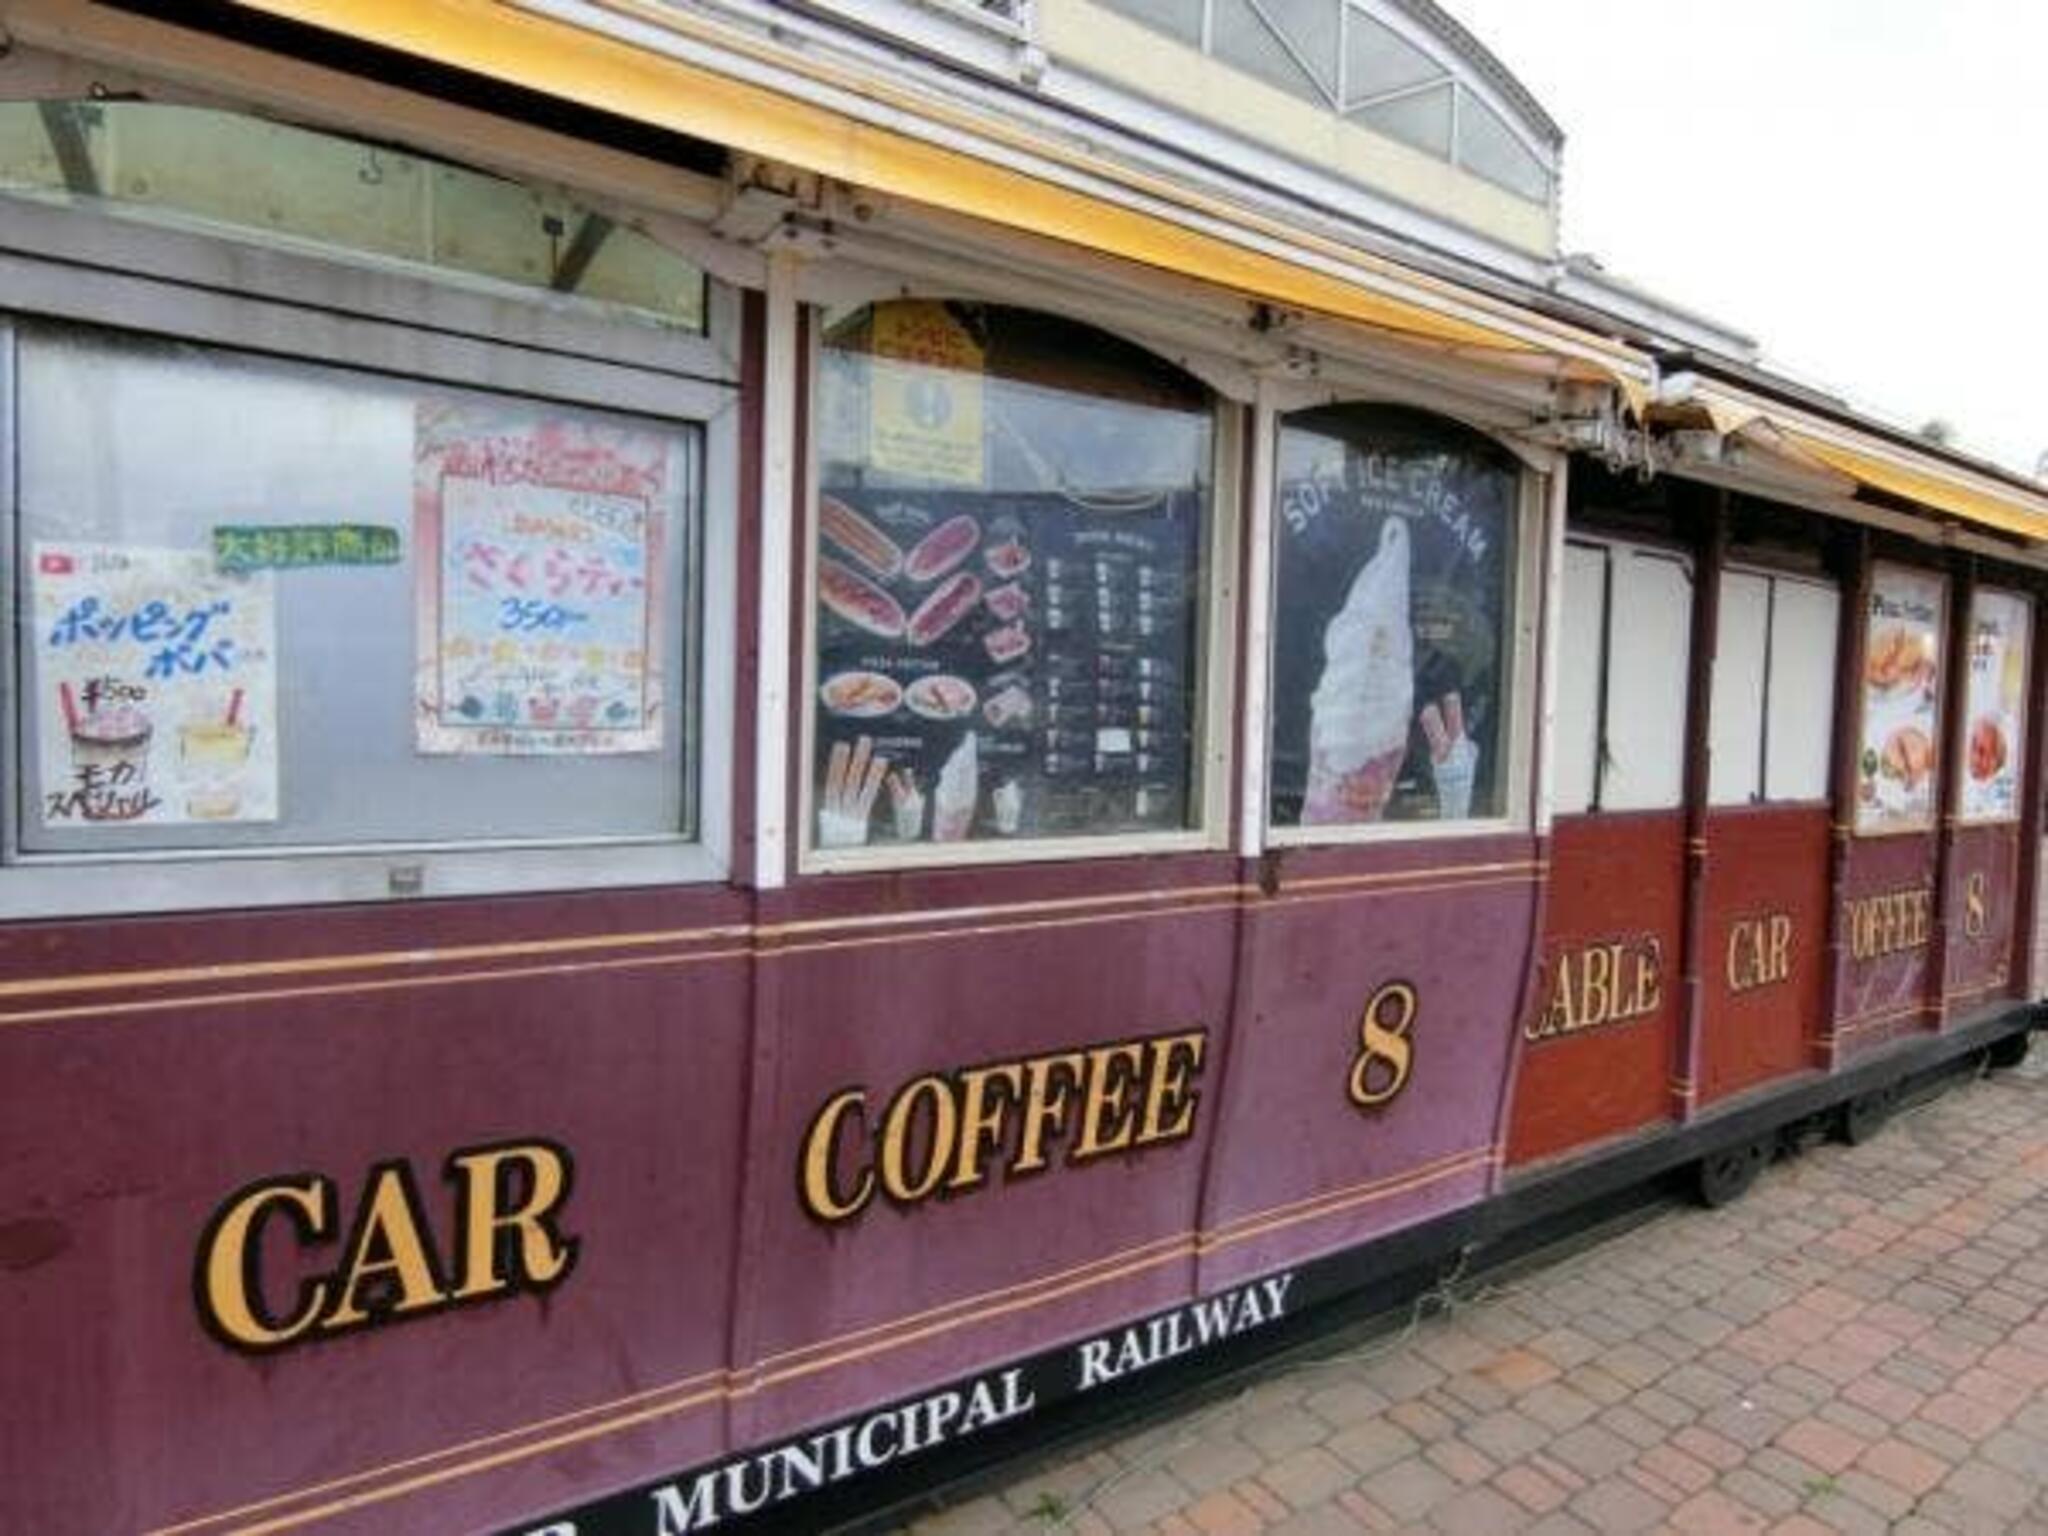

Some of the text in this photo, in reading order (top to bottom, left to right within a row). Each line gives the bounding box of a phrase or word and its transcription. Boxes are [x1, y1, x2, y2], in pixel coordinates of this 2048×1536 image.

[48, 596, 230, 645] ポッピング
[76, 760, 136, 790] モカ
[1725, 915, 1792, 993] CAR
[1963, 873, 1987, 937] 8
[197, 980, 1418, 1354] CAR COFFEE 8
[650, 1275, 1297, 1536] MUNICIPAL RAILWAY
